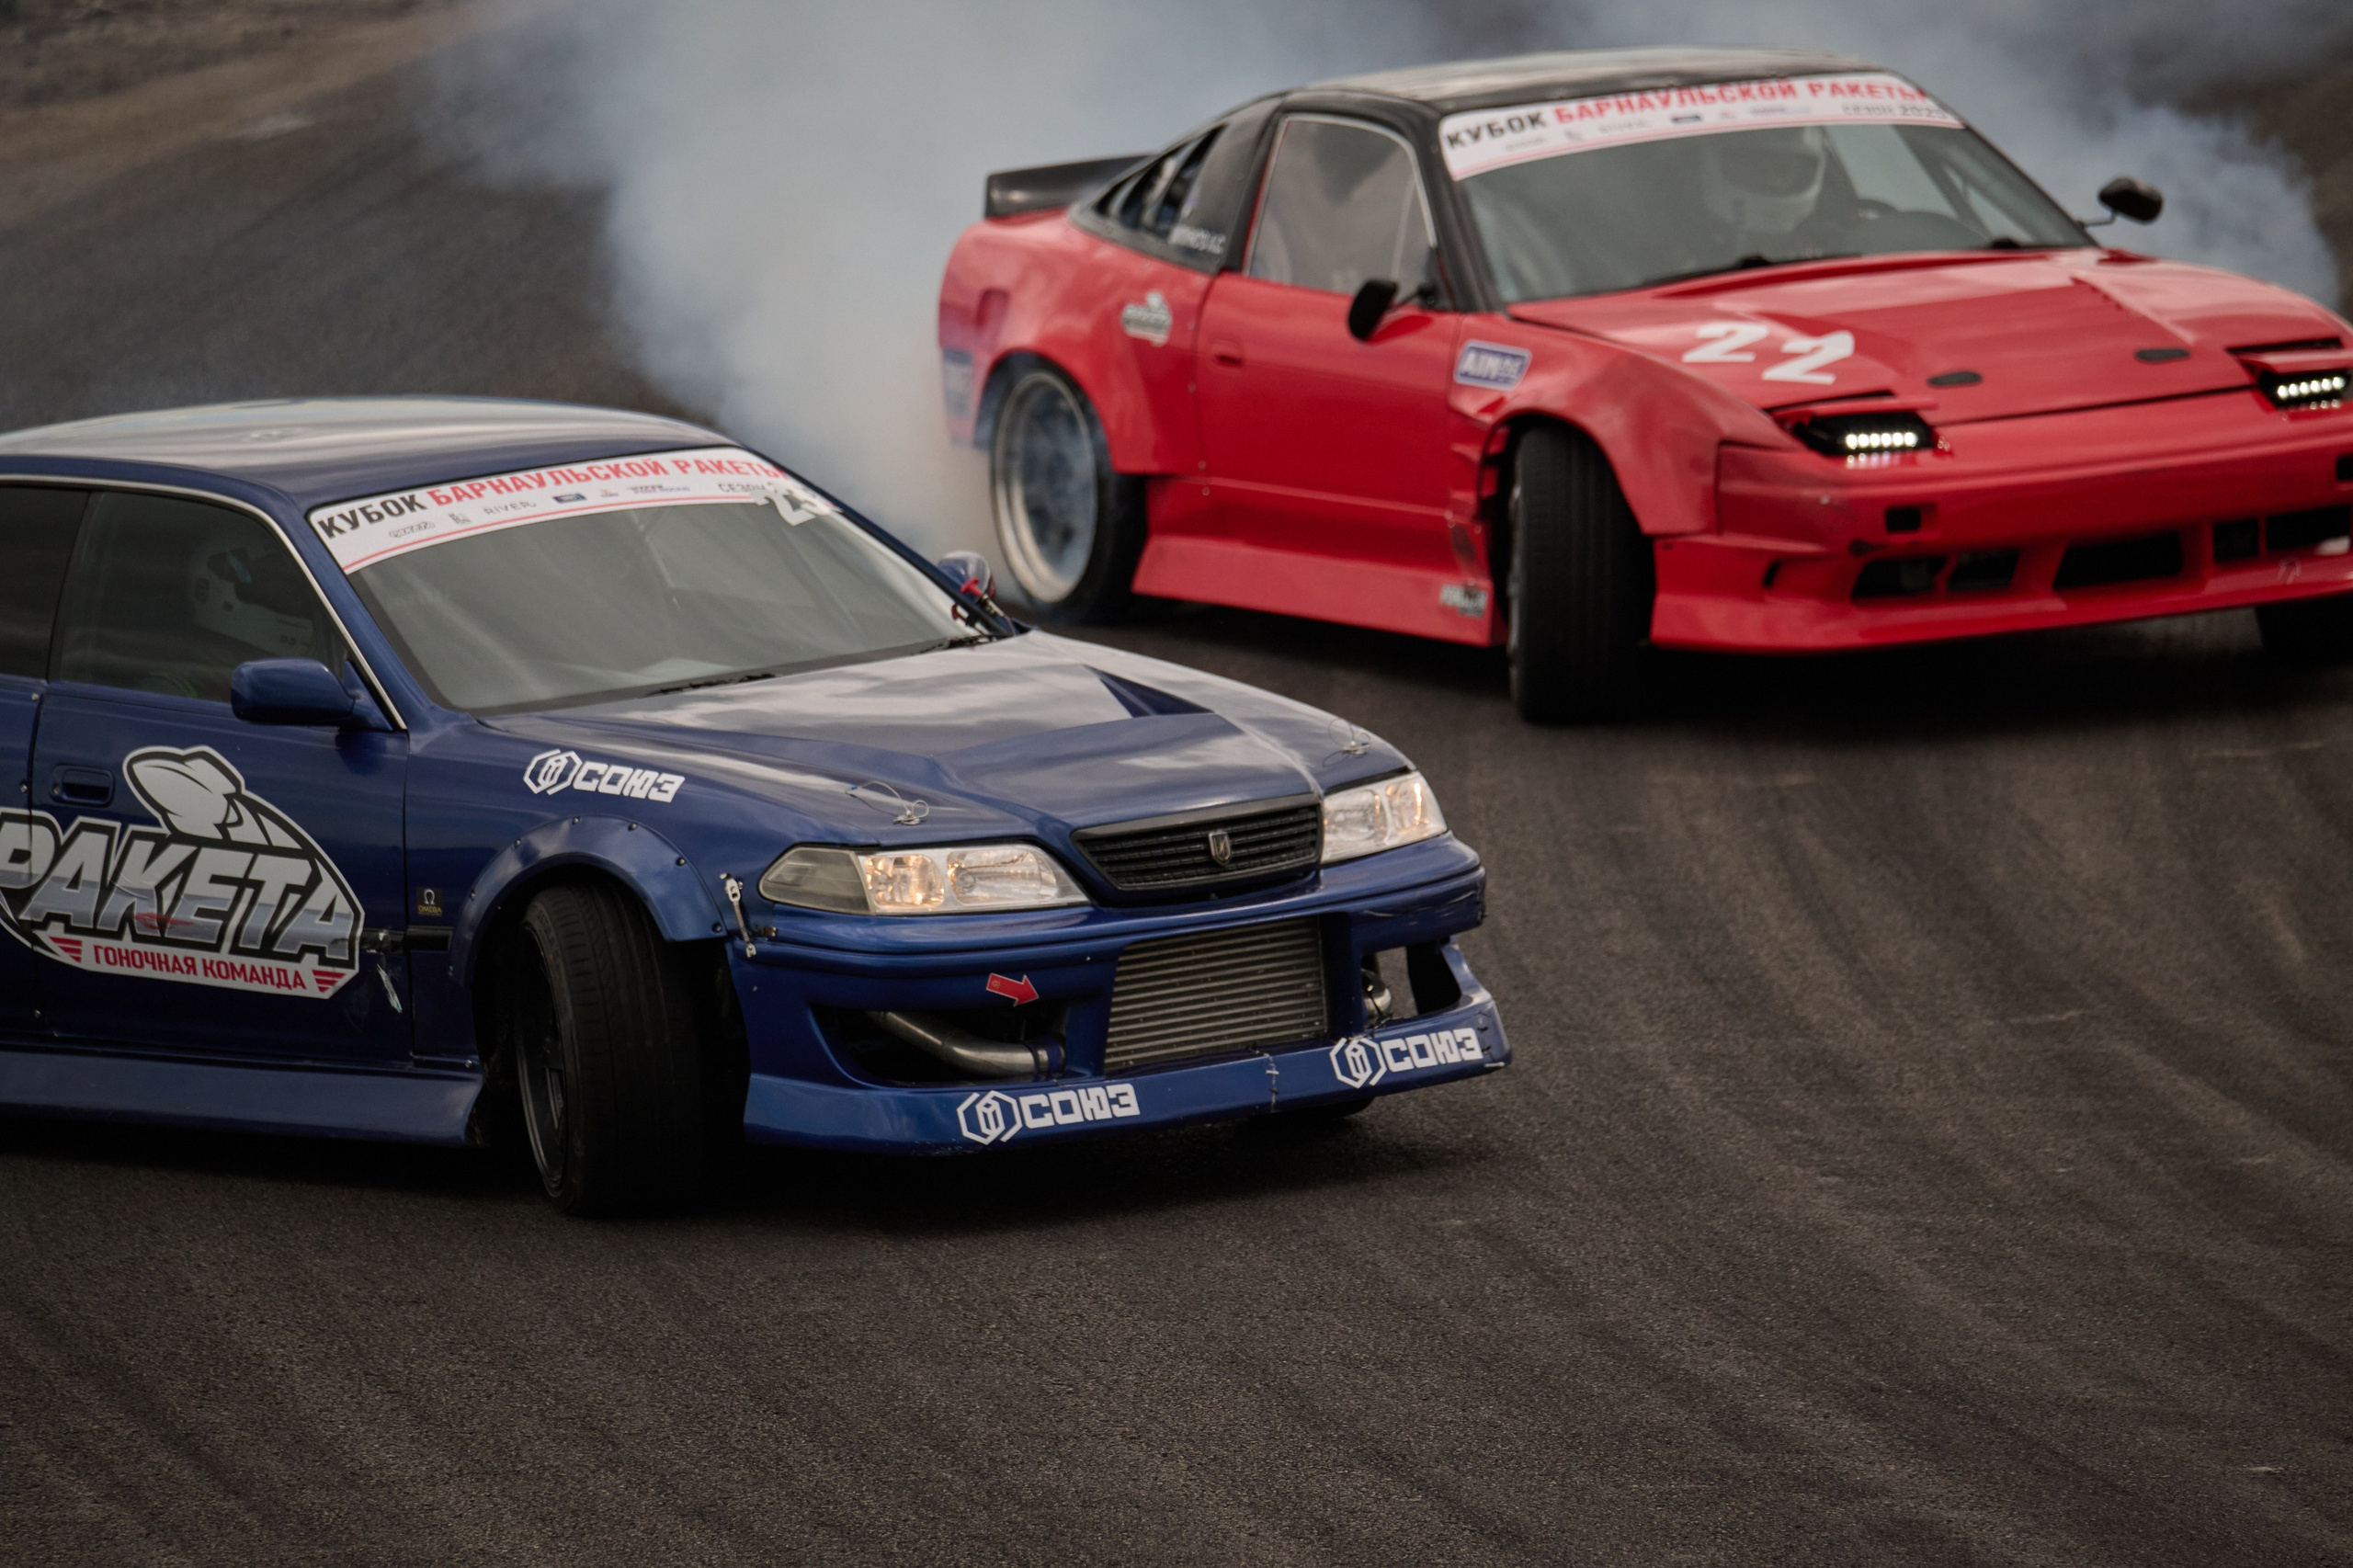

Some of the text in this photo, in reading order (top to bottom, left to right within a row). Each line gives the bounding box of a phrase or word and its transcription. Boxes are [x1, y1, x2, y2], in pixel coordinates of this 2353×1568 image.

[1446, 111, 1547, 149] КУБОК
[1554, 77, 1799, 124] БАРНАУЛЬСКОЙ
[1681, 323, 1855, 385] 22
[318, 458, 790, 539] КУБОК БАРНАУЛЬСКОЙ РАКЕТЫ
[573, 760, 686, 803] СОЮЗ
[0, 816, 355, 961] РАКЕТА
[95, 946, 308, 991] ГОНОЧНАЯ КОМАНДА
[1383, 1028, 1483, 1073] СОЮЗ
[1018, 1083, 1141, 1129] СОЮЗ
